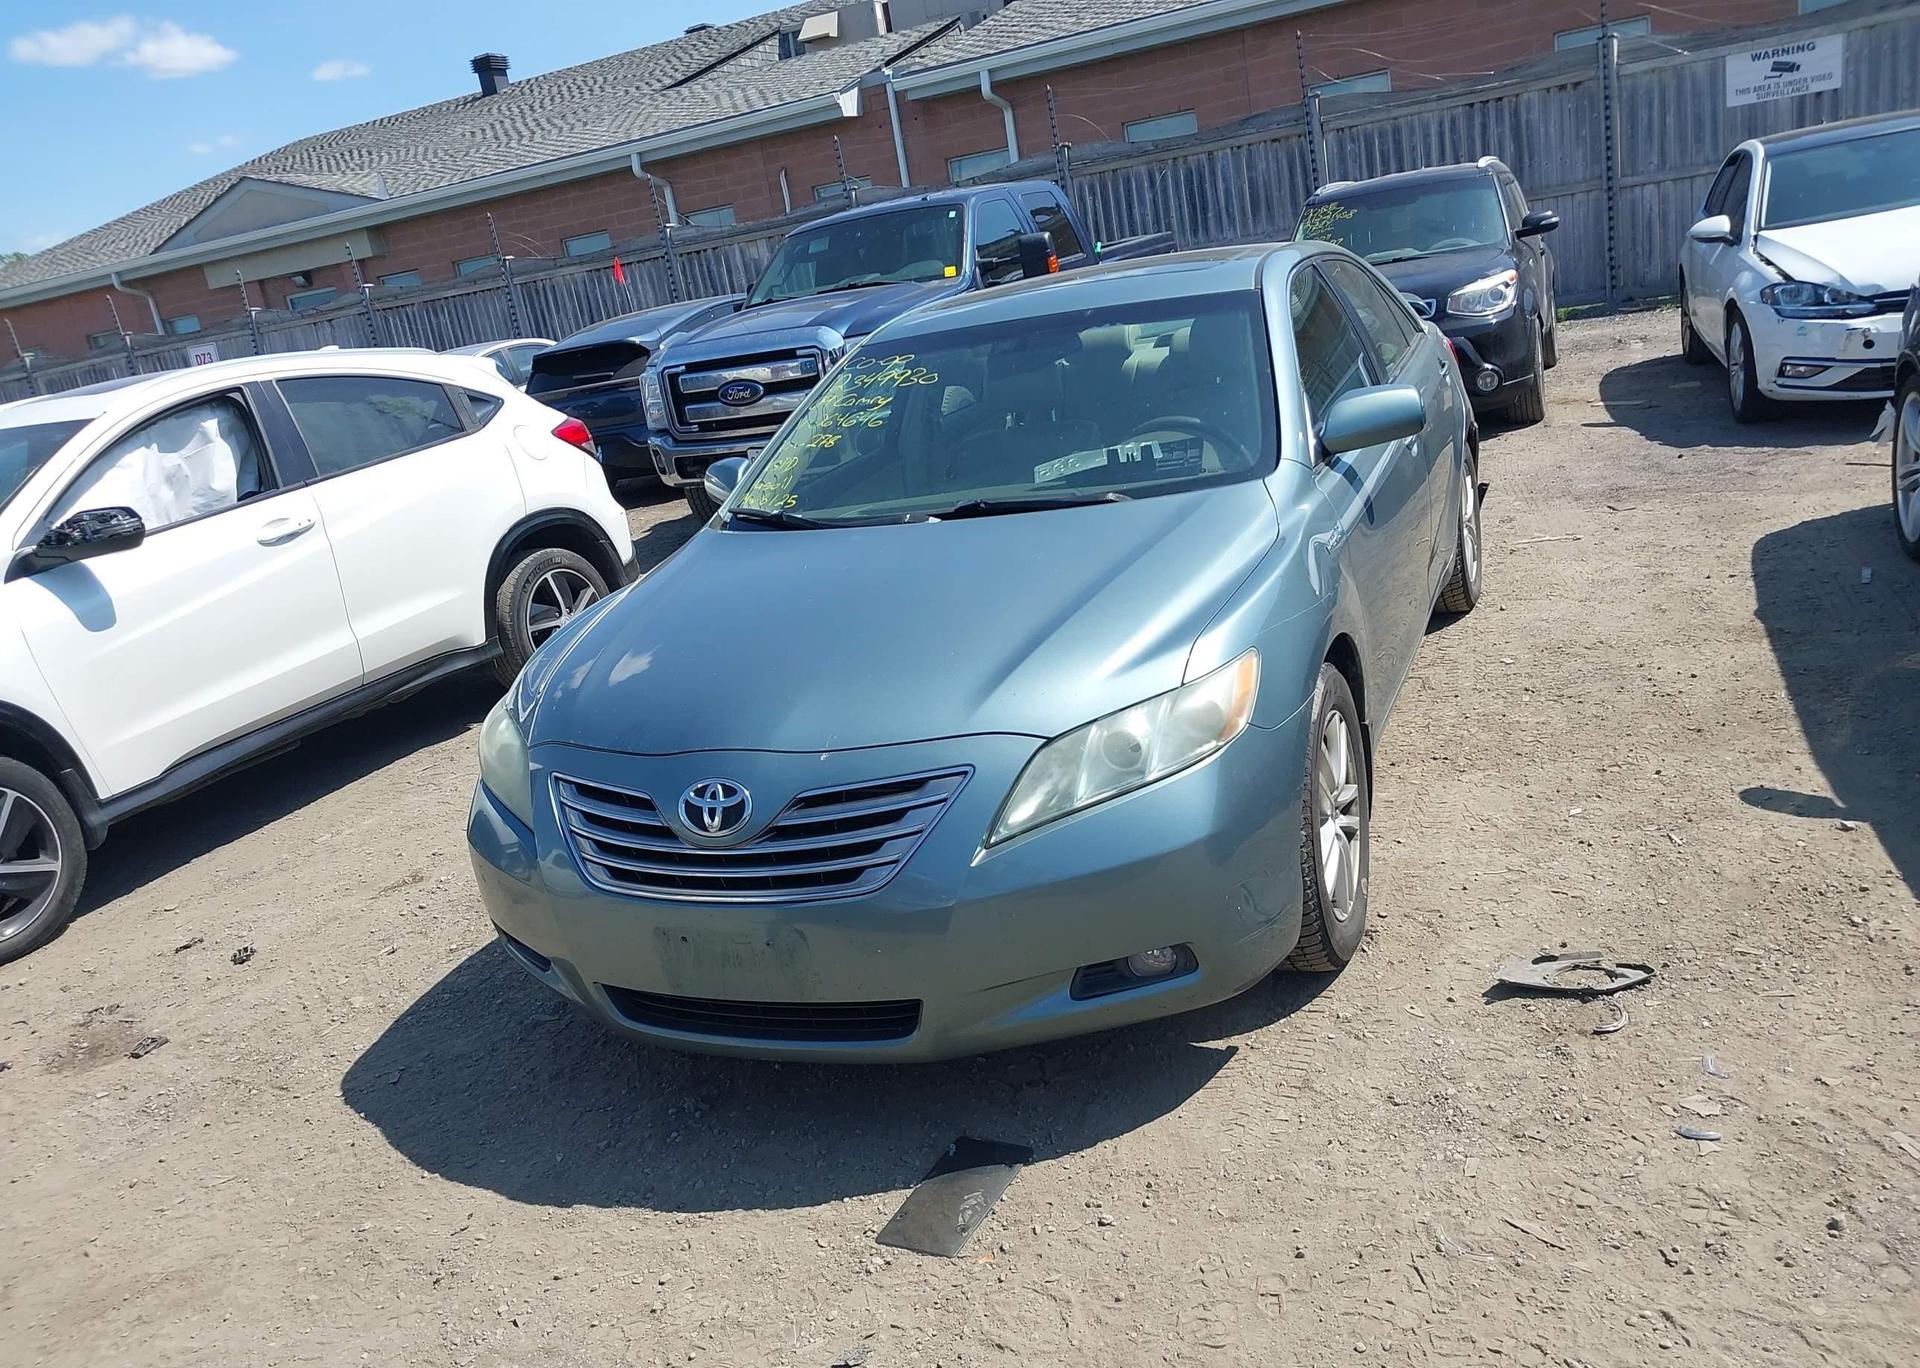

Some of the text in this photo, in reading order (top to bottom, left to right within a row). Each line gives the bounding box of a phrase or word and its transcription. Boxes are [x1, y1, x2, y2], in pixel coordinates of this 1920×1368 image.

[1751, 42, 1816, 62] WARNING
[1735, 72, 1833, 97] THIS AREA IS UNDER VIDEO
[1756, 85, 1810, 100] SURVEILLANCE
[195, 352, 213, 365] DZ3
[727, 386, 752, 401] Ford
[833, 393, 894, 411] Camry
